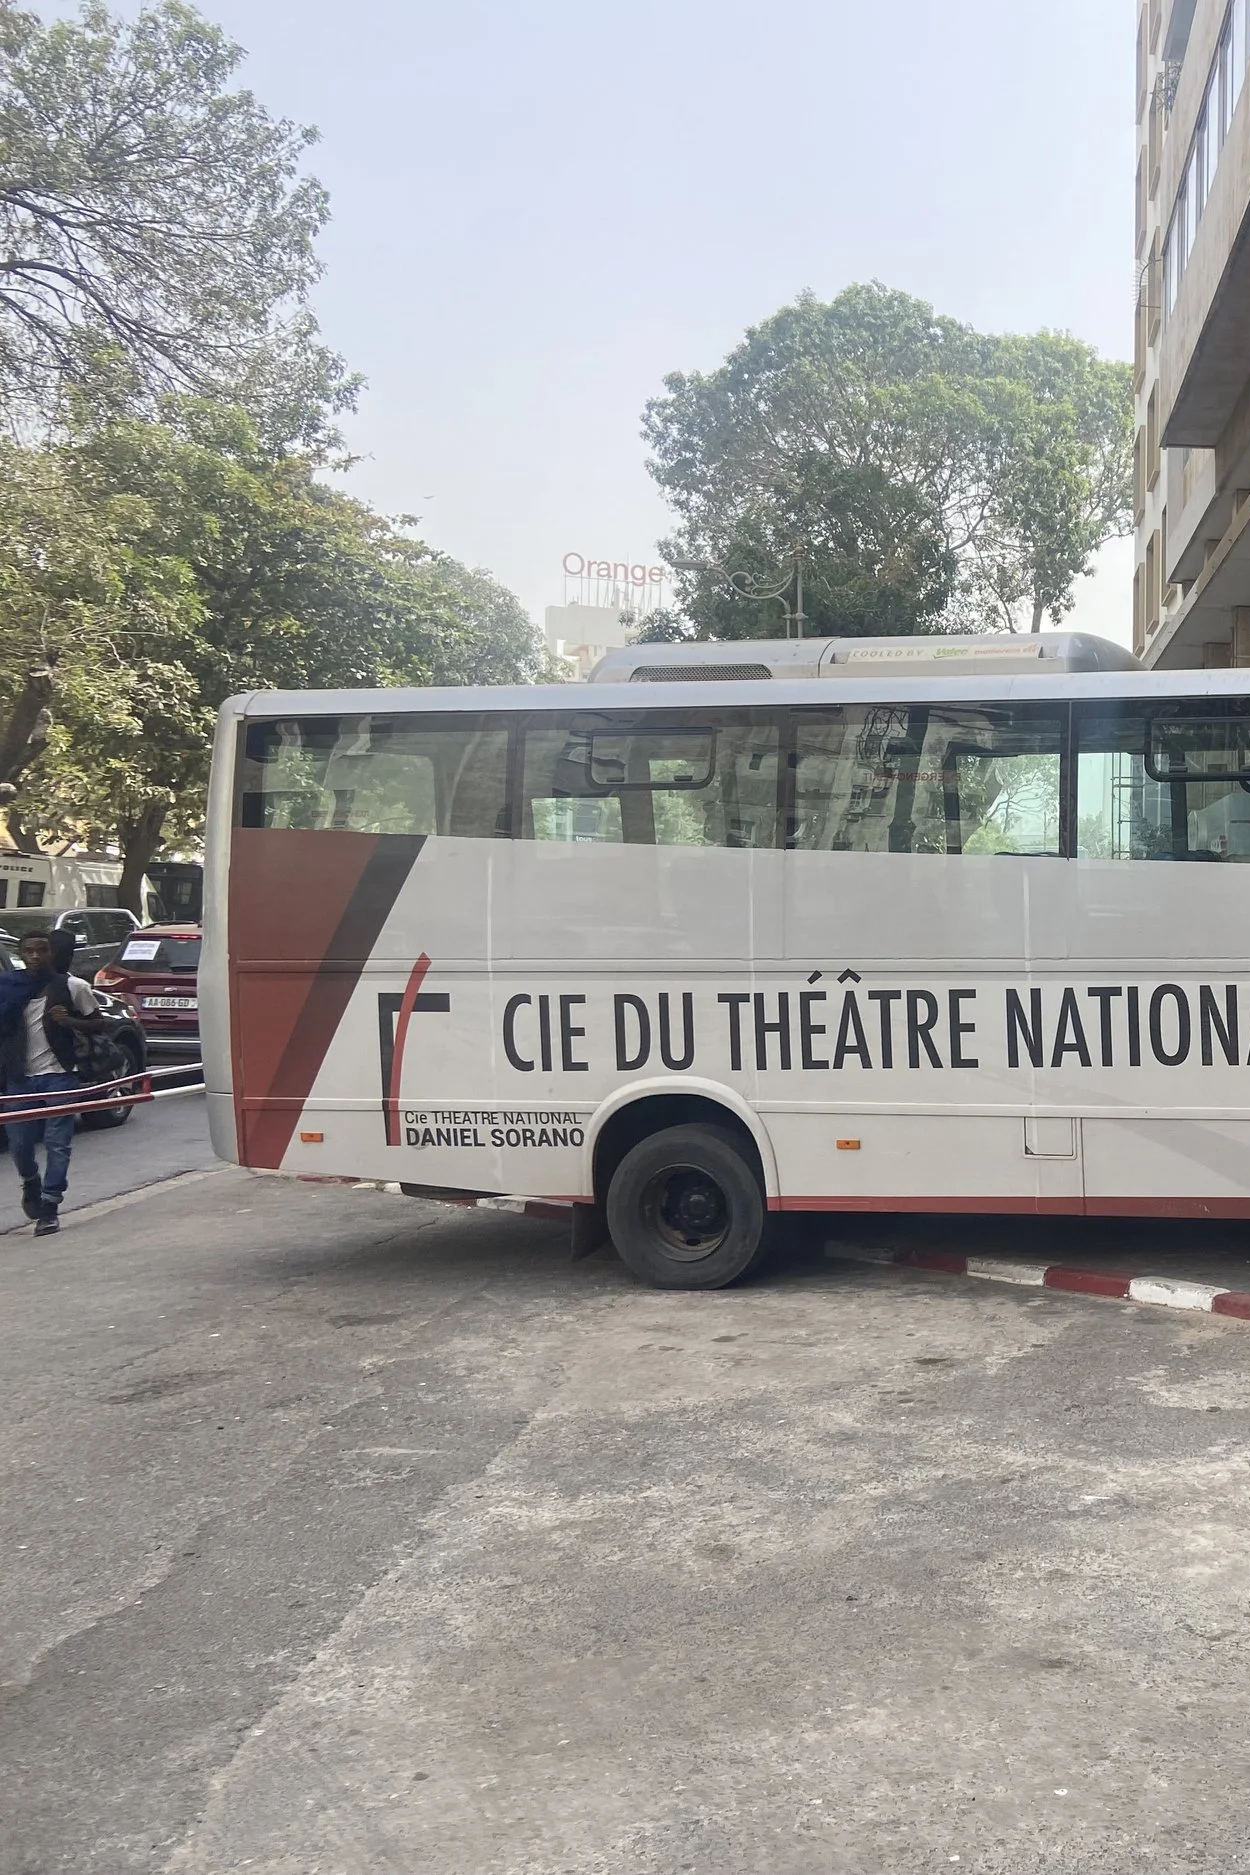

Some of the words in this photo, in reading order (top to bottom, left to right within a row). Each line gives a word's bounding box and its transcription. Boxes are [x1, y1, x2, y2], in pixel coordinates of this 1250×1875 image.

[563, 552, 664, 586] Orange
[907, 648, 925, 656] BY
[0, 864, 34, 873] OLICE
[502, 993, 589, 1072] CIE
[614, 991, 695, 1072] DU
[717, 968, 979, 1071] THÉÂTRE
[404, 1110, 428, 1124] Cie
[434, 1111, 499, 1124] THEATRE
[503, 1111, 582, 1125] NATIONAL
[406, 1128, 486, 1147] DANIEL
[491, 1128, 585, 1147] SORANO
